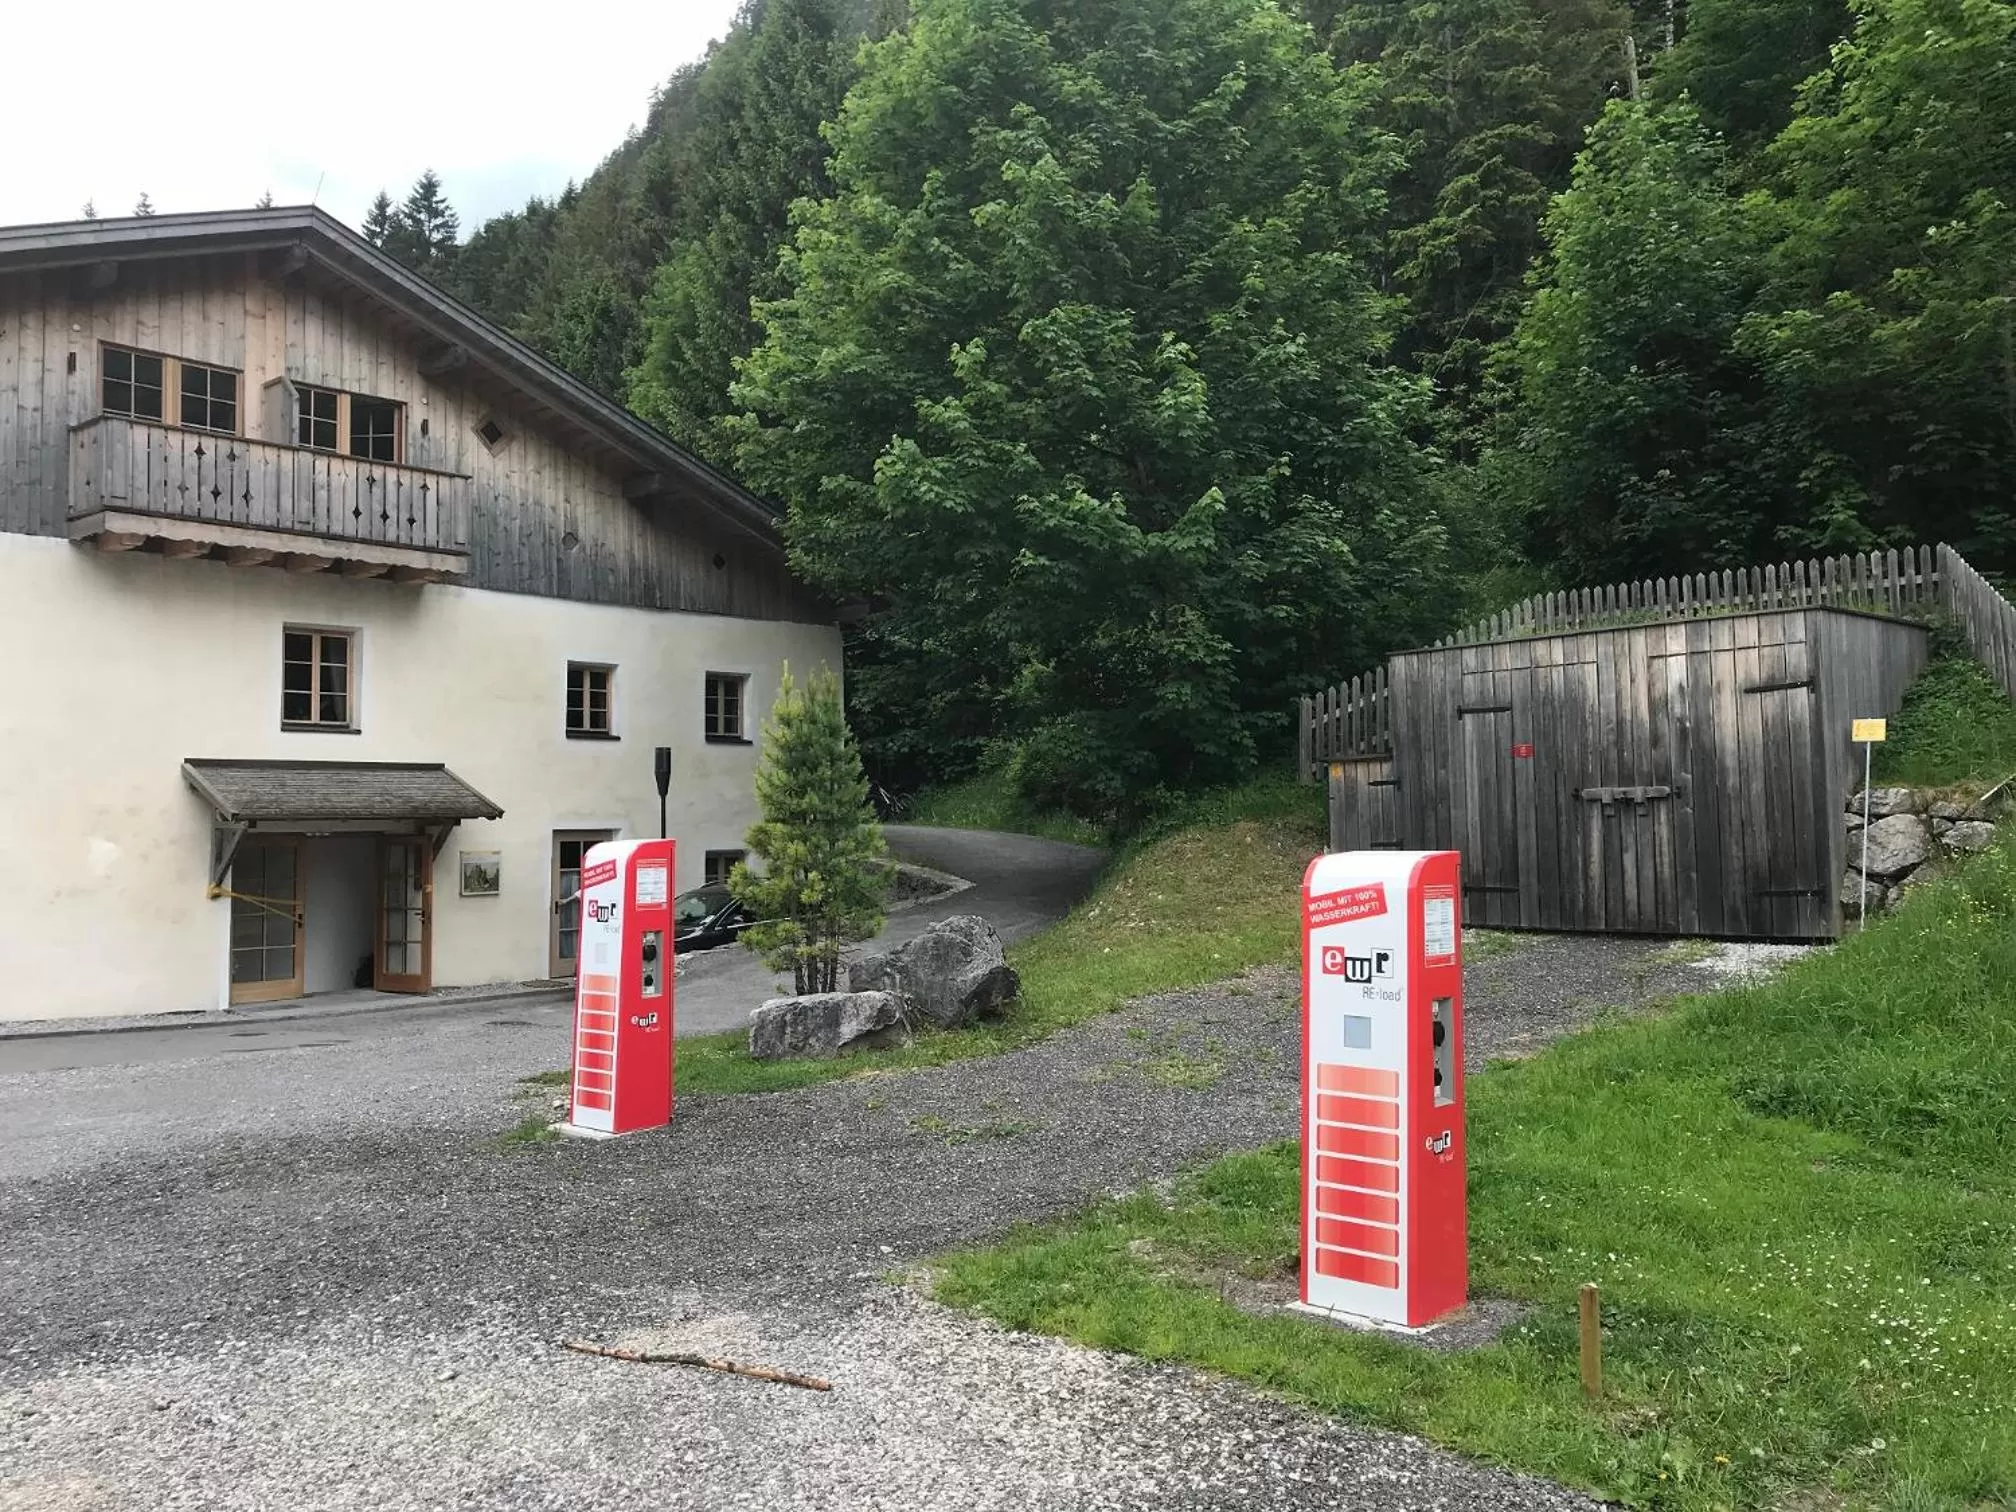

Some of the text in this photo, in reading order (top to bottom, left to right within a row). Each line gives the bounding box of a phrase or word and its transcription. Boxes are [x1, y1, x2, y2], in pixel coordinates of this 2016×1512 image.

[589, 900, 617, 922] ewr
[1308, 889, 1378, 912] MOBIL MIT 100%
[1310, 901, 1380, 924] WASSERKRAFT!
[1323, 947, 1393, 983] ewr
